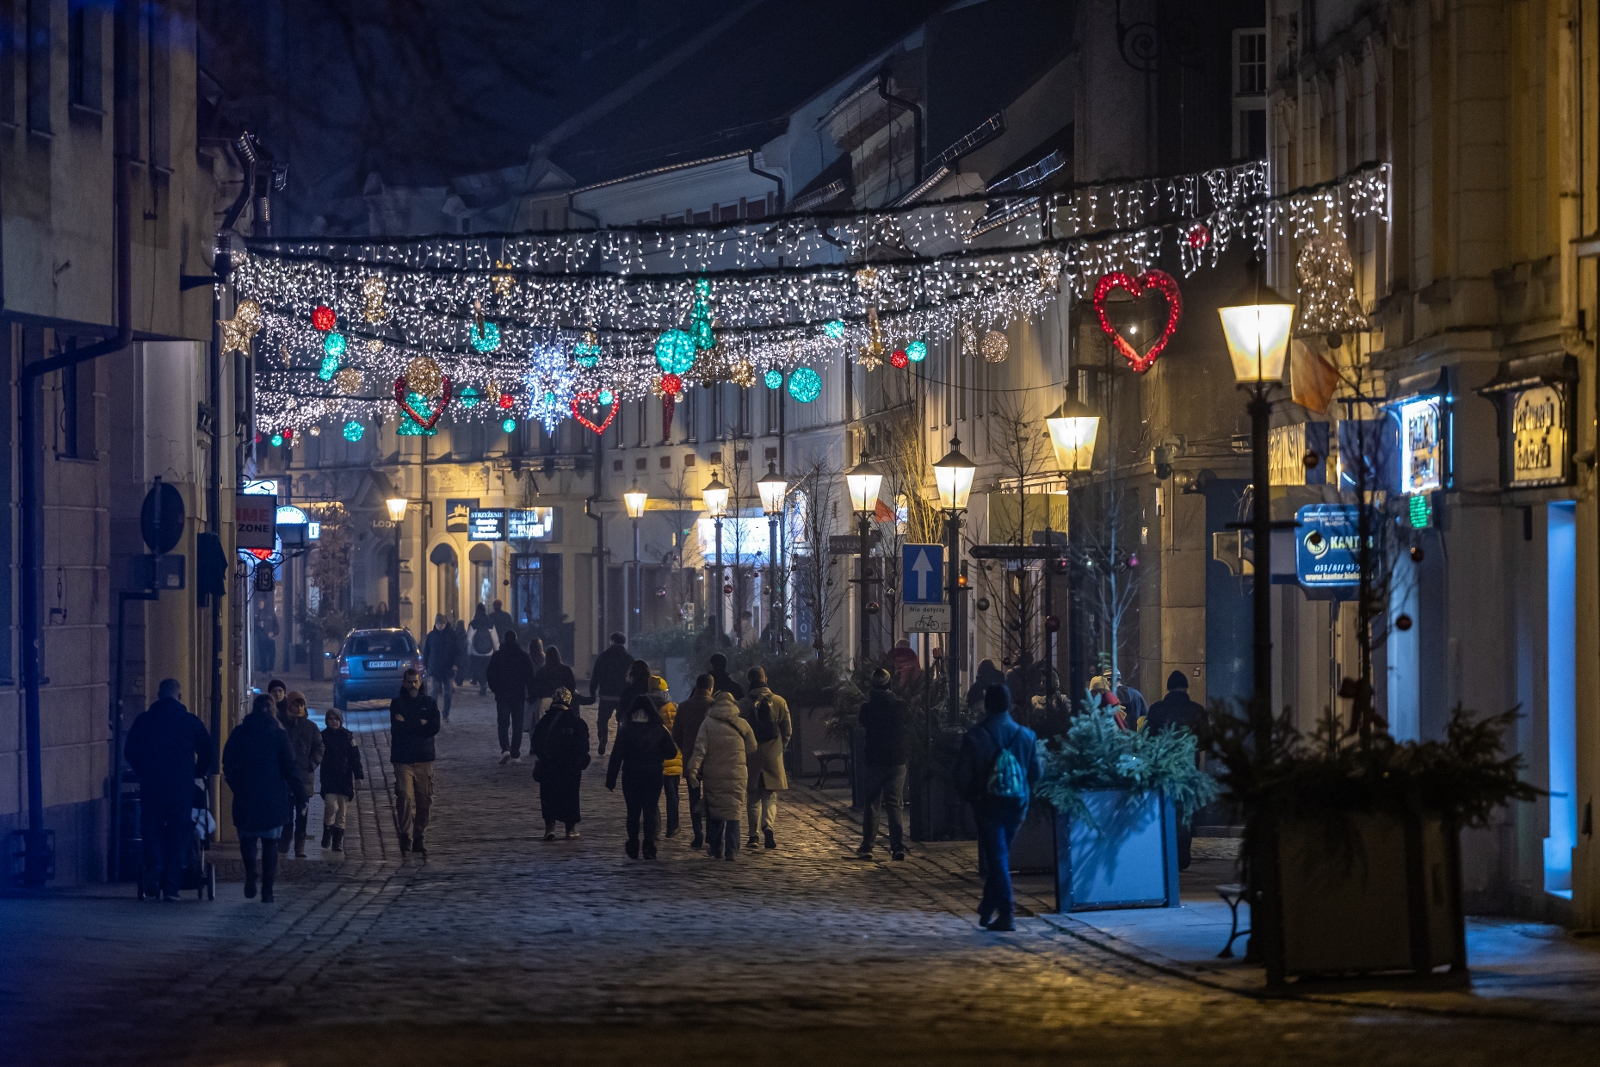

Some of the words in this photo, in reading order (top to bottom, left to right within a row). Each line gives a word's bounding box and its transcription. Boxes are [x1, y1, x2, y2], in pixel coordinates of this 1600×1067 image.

[238, 523, 270, 533] ZONE
[259, 571, 270, 587] 19
[922, 606, 945, 614] dotyczy
